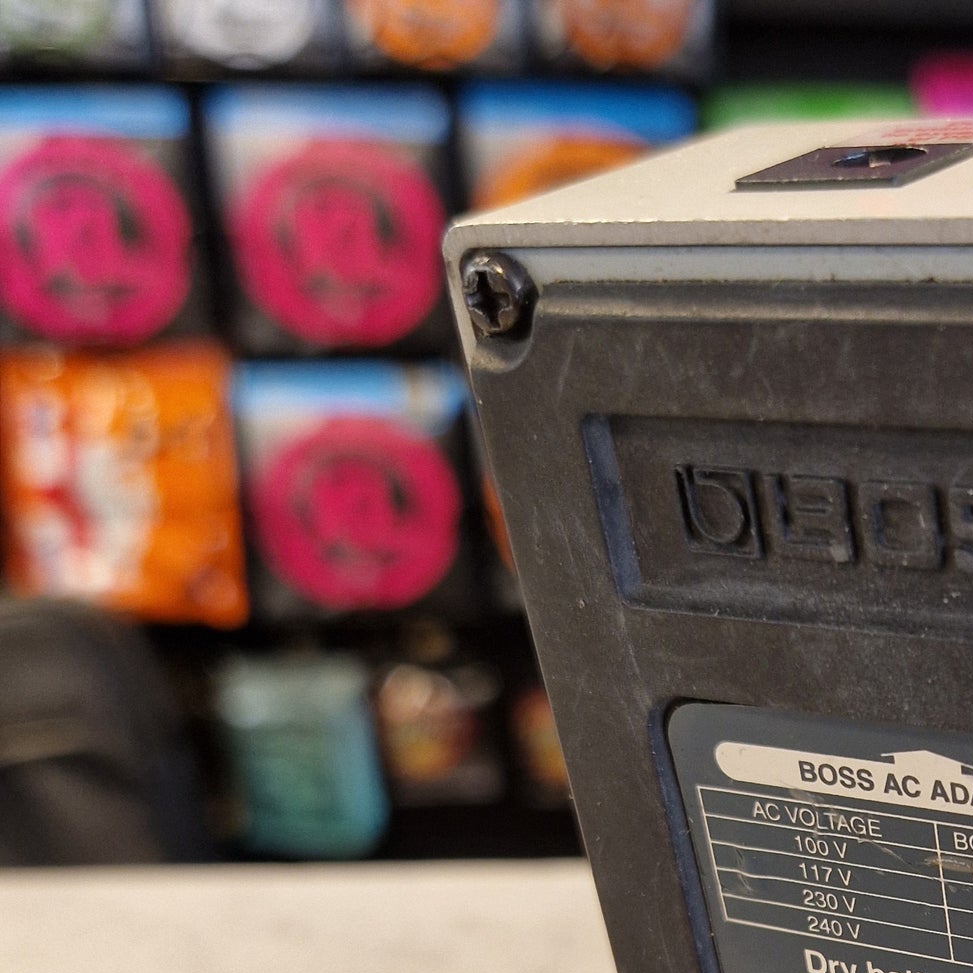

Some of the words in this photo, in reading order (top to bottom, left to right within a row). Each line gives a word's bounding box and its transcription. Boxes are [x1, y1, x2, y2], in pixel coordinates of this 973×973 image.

[798, 760, 875, 792] BOSS
[883, 772, 921, 799] AC
[752, 800, 781, 821] AC
[784, 805, 883, 838] VOLTAGE
[794, 835, 829, 856] 100
[833, 840, 847, 859] V
[798, 862, 833, 883] 117
[837, 868, 852, 886] V
[802, 888, 839, 911] 230
[842, 895, 856, 913] V
[807, 915, 843, 937] 240
[846, 922, 860, 940] V
